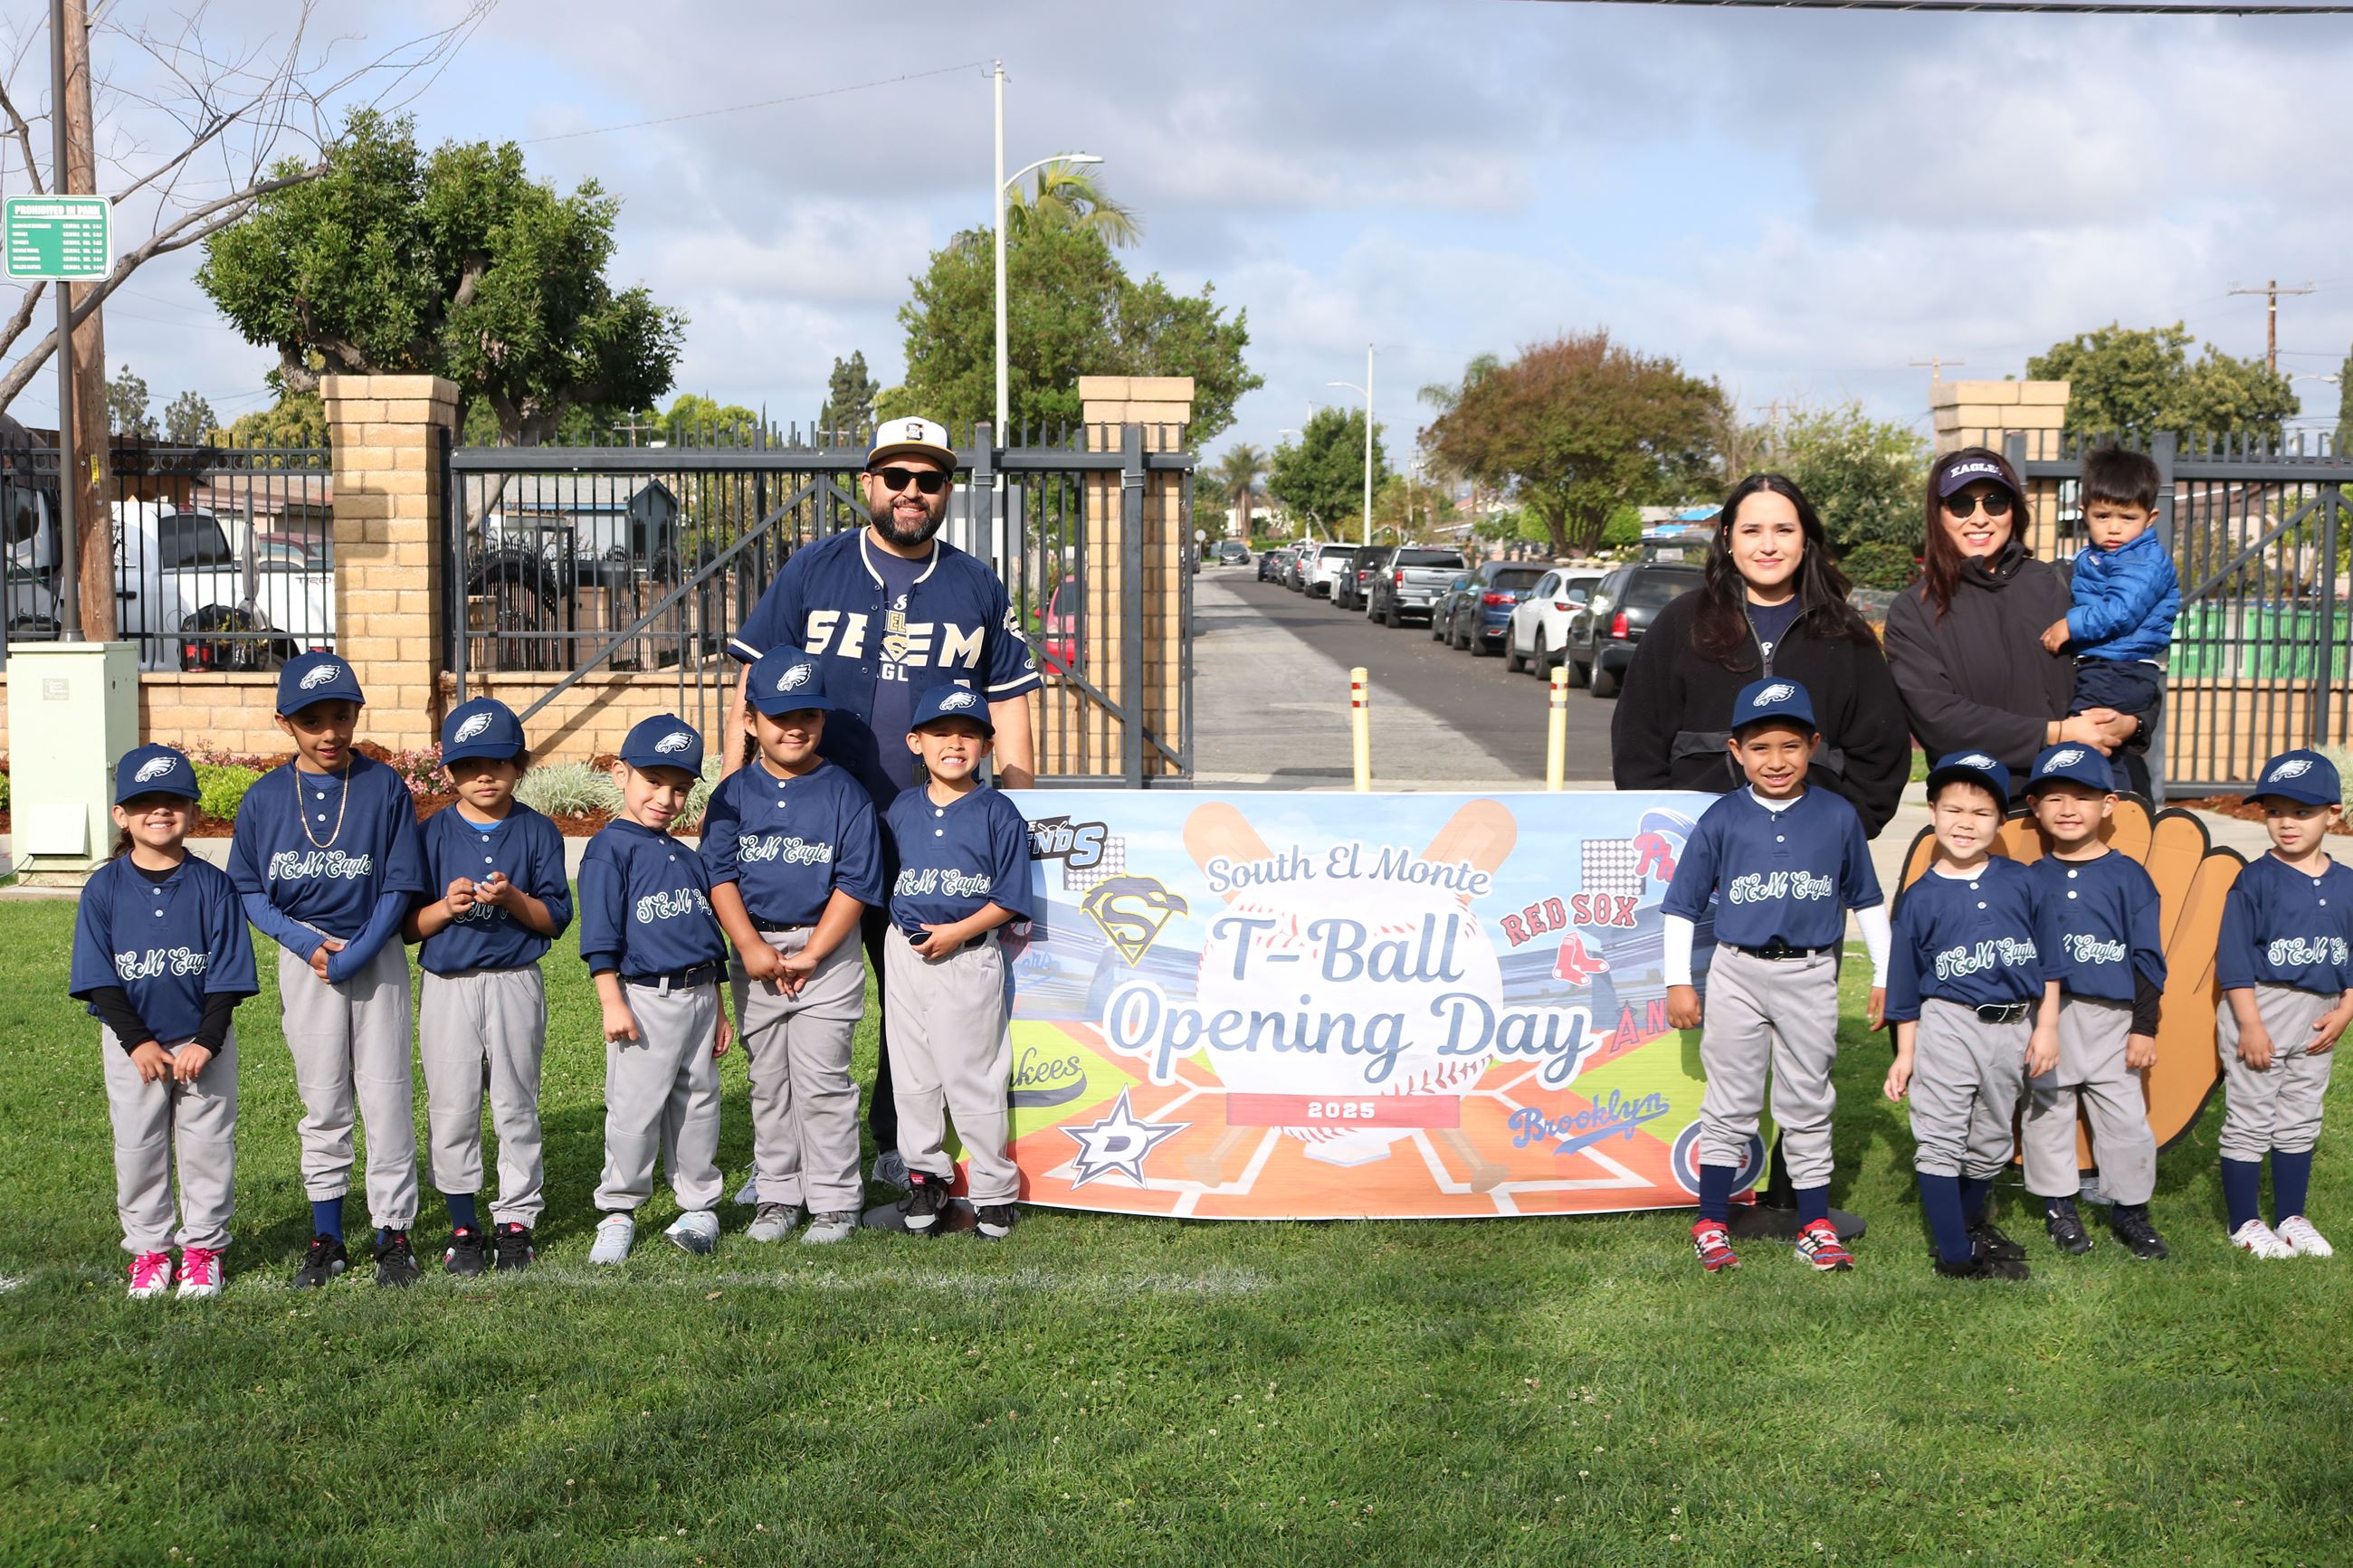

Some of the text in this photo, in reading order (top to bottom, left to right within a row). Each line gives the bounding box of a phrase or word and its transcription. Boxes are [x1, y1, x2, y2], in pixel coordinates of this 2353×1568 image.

[940, 869, 992, 898] Eagles
[1207, 843, 1490, 895] South El Monte
[1729, 870, 1789, 905] SEM
[636, 888, 692, 924] SEM
[1500, 893, 1639, 947] RED SOX
[1212, 912, 1465, 984] T-Ball
[1935, 940, 1996, 981] SEM
[2073, 934, 2127, 965] Eagles
[1110, 986, 1596, 1084] Opening Day
[1012, 1047, 1081, 1087] kees
[1307, 1101, 1376, 1119] 2025
[1508, 1088, 1671, 1151] Brooklyn
